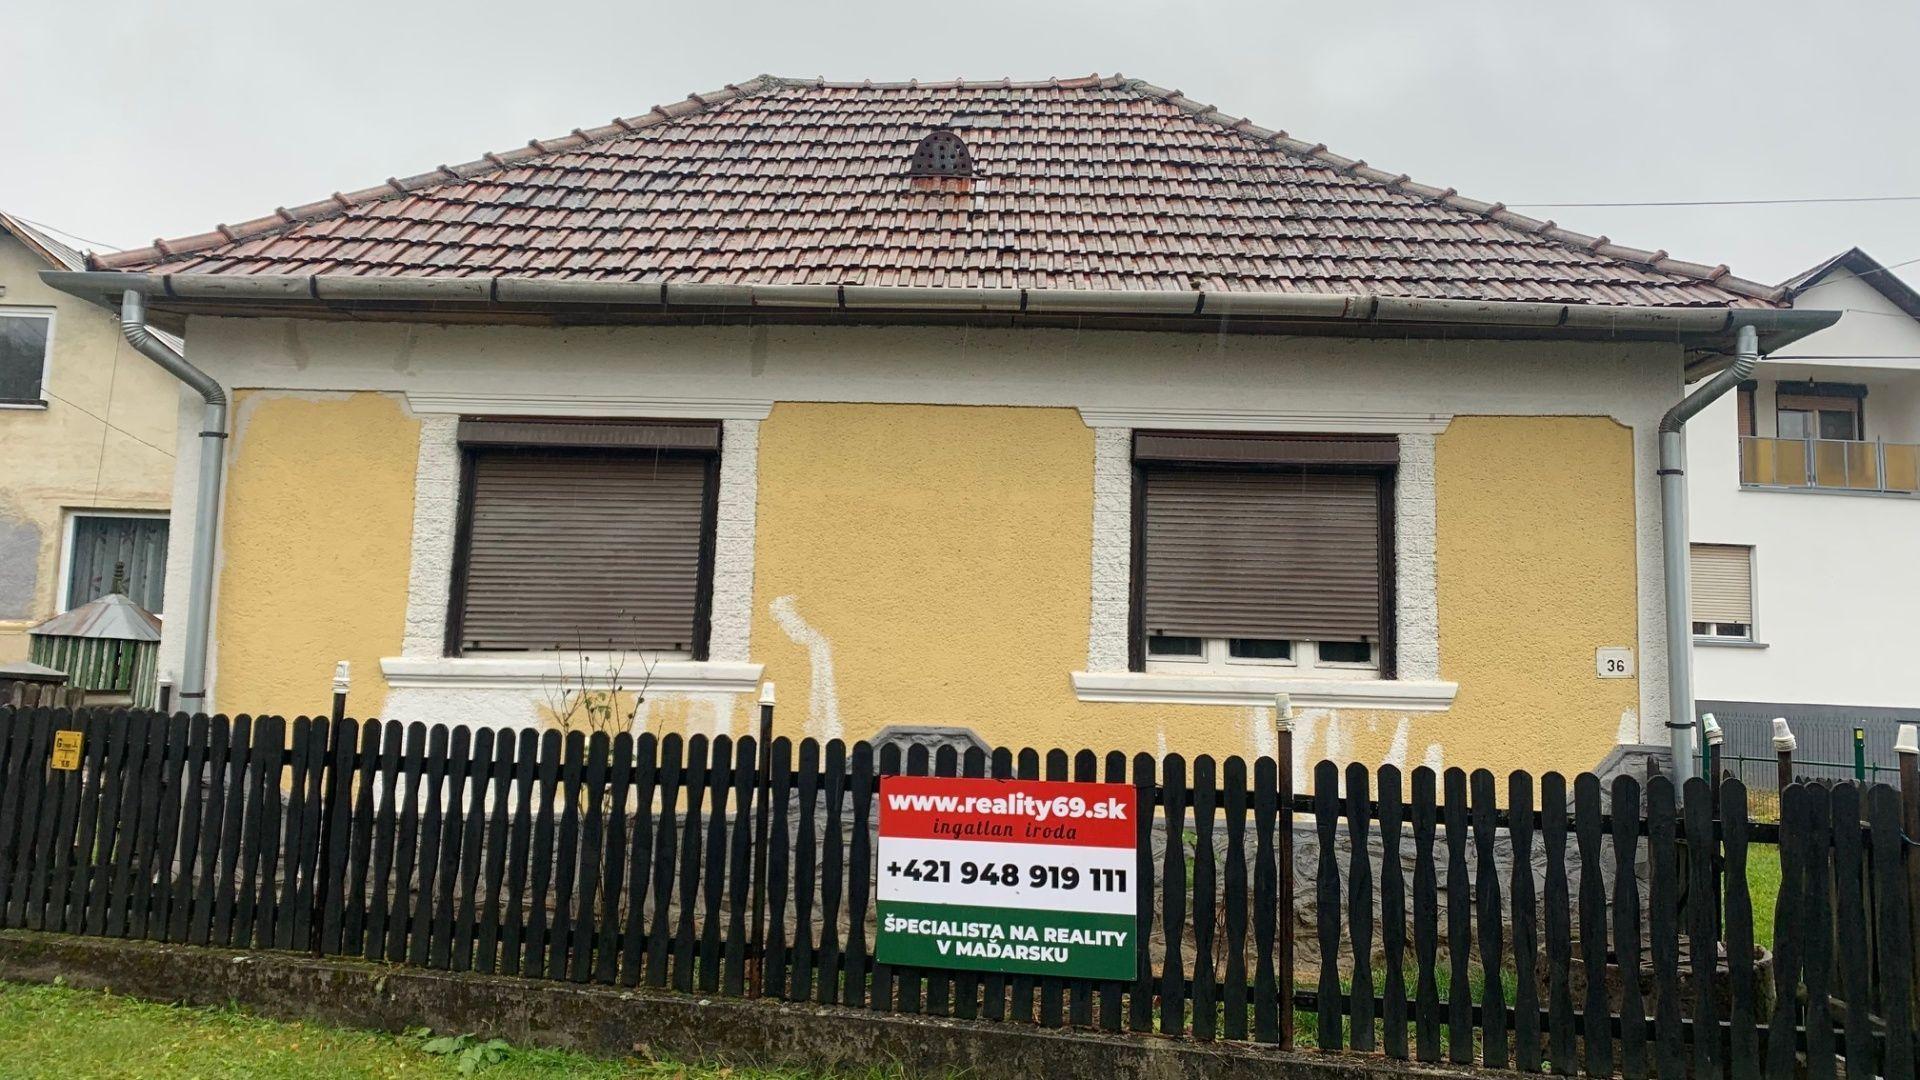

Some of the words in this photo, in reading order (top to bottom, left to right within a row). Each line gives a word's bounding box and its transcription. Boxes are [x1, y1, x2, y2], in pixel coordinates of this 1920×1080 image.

[1607, 659, 1625, 672] 36
[888, 792, 1127, 821] www.reality69.sk
[933, 818, 1013, 839] ingatlan
[1025, 822, 1077, 839] iroda
[887, 859, 951, 883] +421
[960, 861, 1019, 887] 948
[1029, 864, 1080, 890] 919
[1089, 867, 1127, 893] 111
[884, 913, 1004, 940] ŠPECIALISTA
[1009, 925, 1039, 941] NA
[1044, 927, 1128, 947] REALITY
[936, 939, 952, 955] V
[956, 938, 1069, 963] MAĎARSKU
